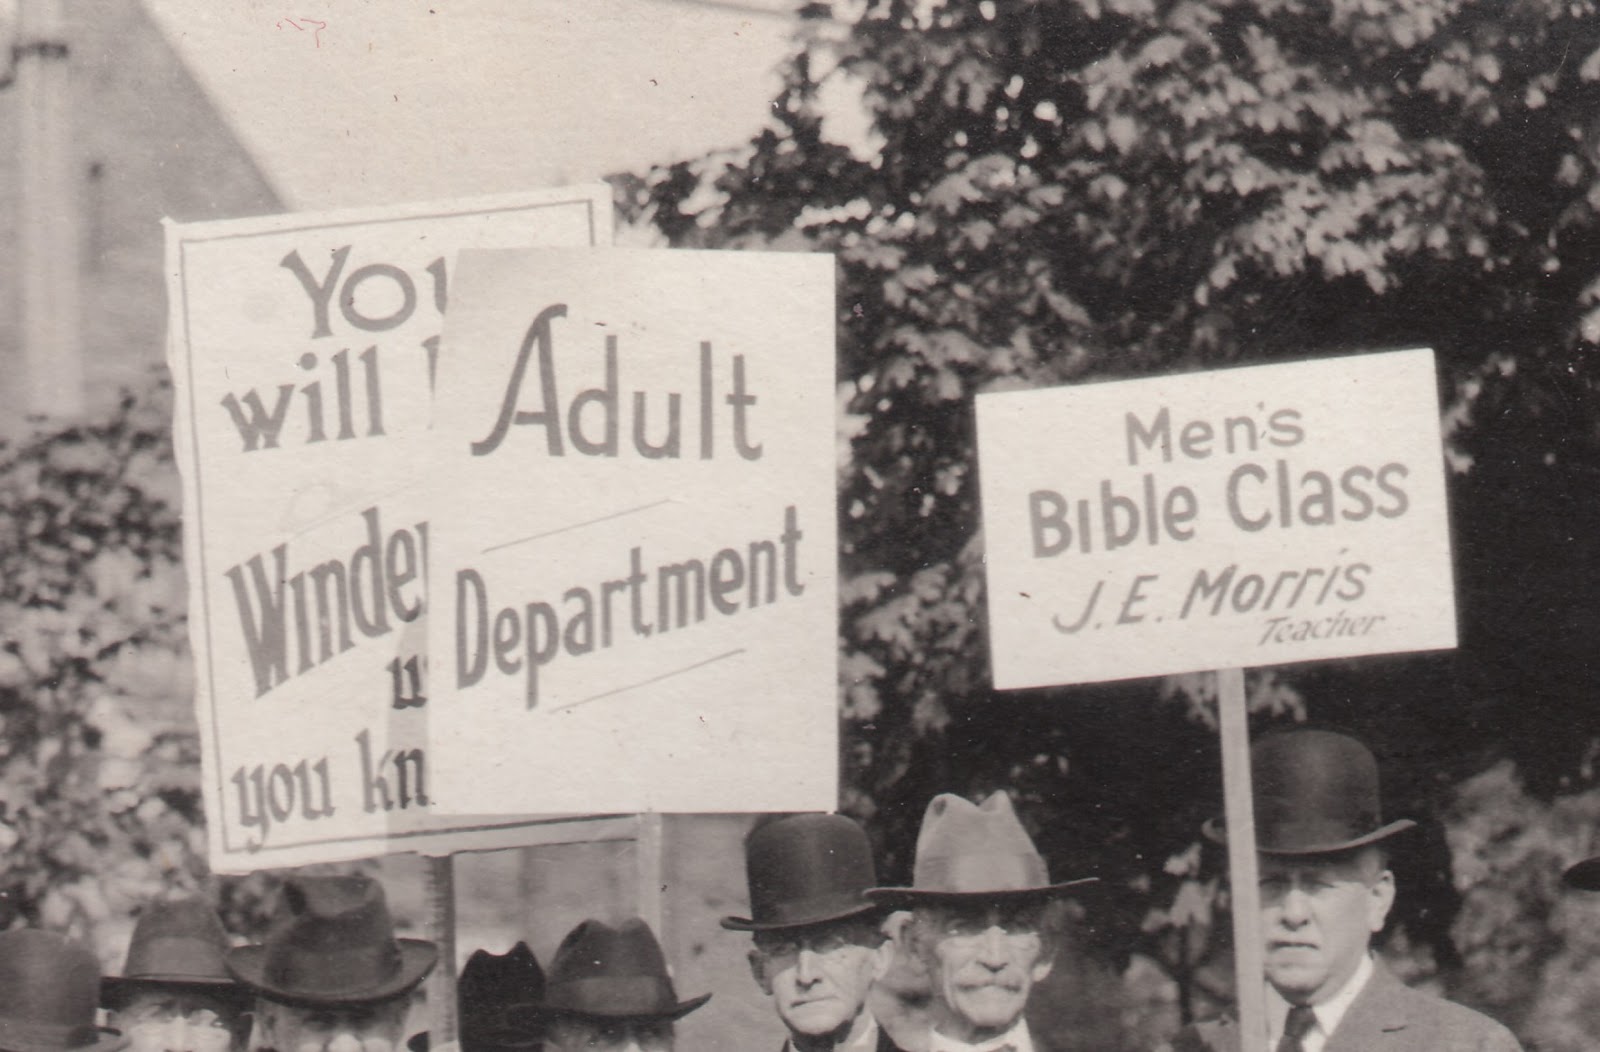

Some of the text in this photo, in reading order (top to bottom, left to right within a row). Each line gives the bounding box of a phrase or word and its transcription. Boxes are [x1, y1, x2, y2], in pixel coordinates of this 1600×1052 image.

[220, 345, 386, 452] will
[470, 303, 763, 460] Adult
[1125, 401, 1305, 466] Men's
[1028, 459, 1410, 559] Bible Class
[456, 505, 805, 710] Department
[1180, 548, 1372, 620] Morris
[1257, 608, 1386, 647] Teacher
[231, 757, 336, 854] you
